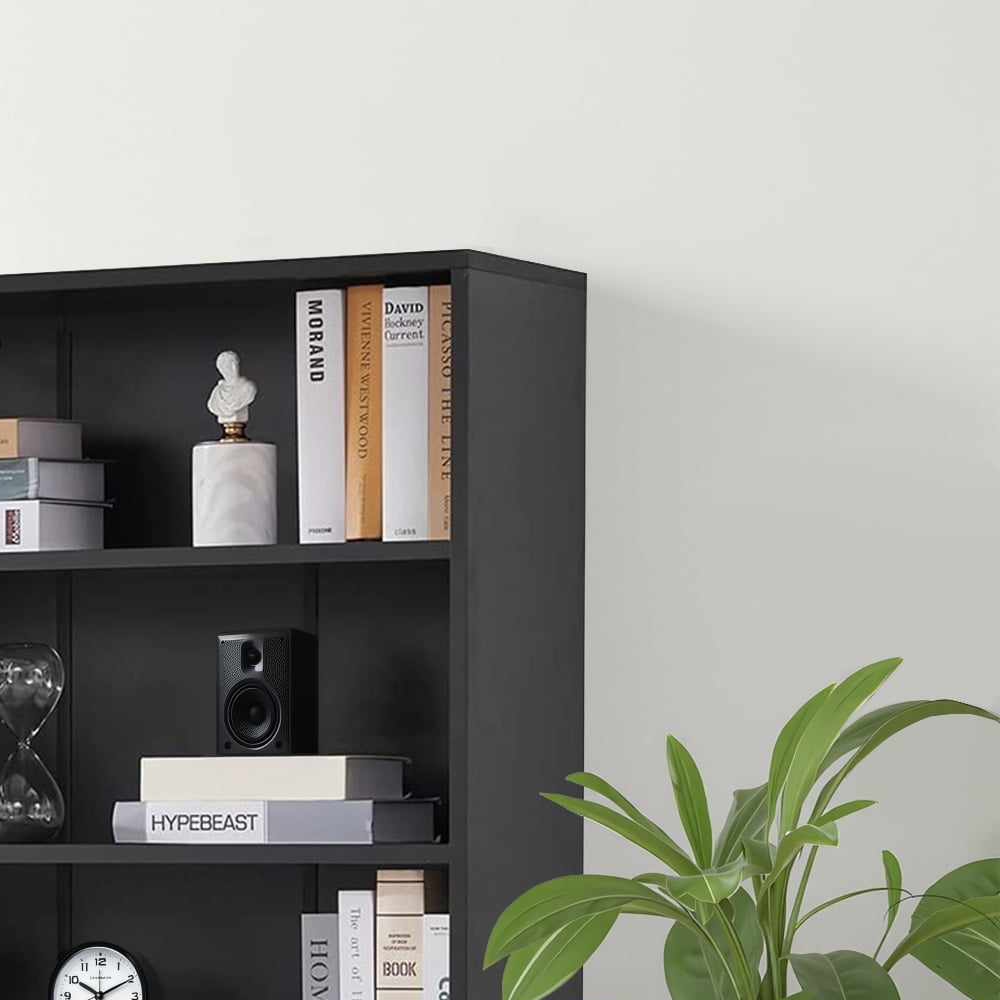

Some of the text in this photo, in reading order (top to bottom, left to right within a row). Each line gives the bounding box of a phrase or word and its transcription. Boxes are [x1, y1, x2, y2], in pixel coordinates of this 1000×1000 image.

[384, 301, 424, 315] DAVID
[384, 316, 424, 329] Hockney
[307, 300, 325, 382] MORAND
[358, 301, 373, 369] VIVIENNE
[384, 330, 424, 341] Current
[440, 301, 451, 378] PICASSO
[358, 373, 371, 459] WESTWOOD
[440, 438, 451, 481] LINE
[151, 814, 258, 831] HYPEBEAST
[350, 907, 361, 930] The
[350, 937, 360, 959] art
[81, 962, 89, 972] 11
[94, 957, 107, 966] 12
[383, 961, 417, 976] BOOK
[68, 975, 79, 985] 10
[127, 974, 134, 983] 2
[351, 966, 361, 982] of
[64, 991, 72, 1000] 9
[131, 991, 139, 1000] 3
